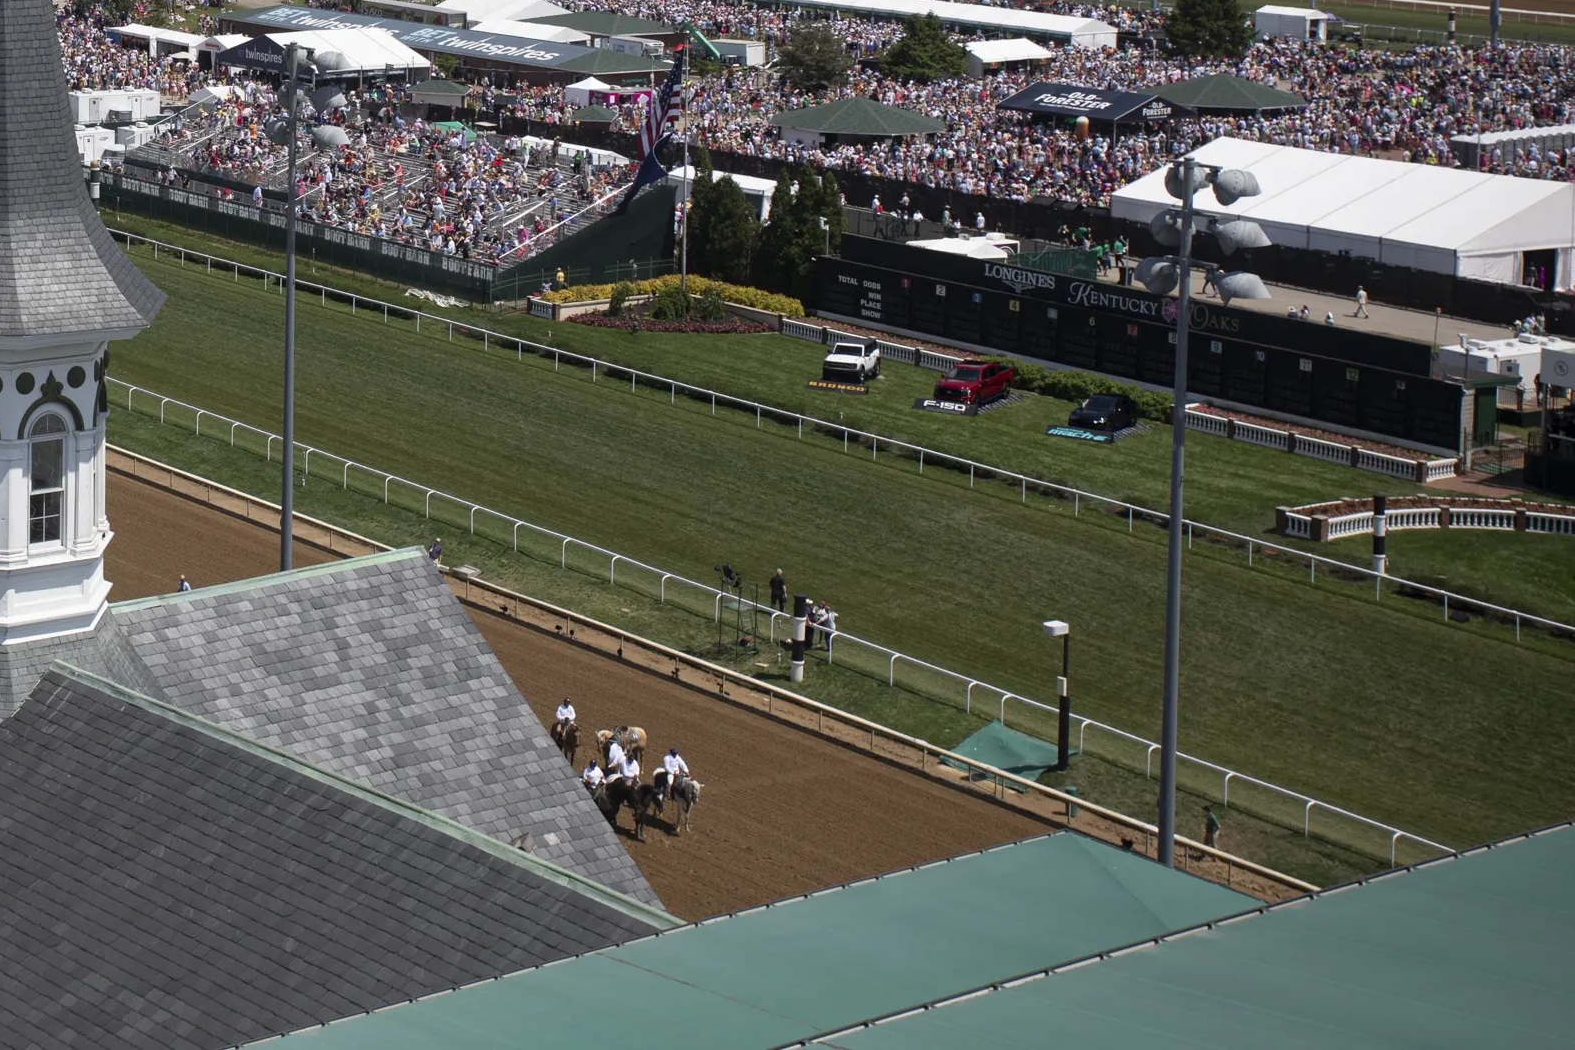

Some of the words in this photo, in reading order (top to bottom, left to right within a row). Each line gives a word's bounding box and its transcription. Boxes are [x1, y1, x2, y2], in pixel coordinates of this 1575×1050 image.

[267, 7, 310, 18] BET
[409, 28, 457, 39] BET
[438, 36, 559, 61] twinspires
[245, 45, 283, 64] twinspires
[1068, 92, 1097, 100] OLD
[1034, 94, 1112, 110] FORESTER
[1142, 108, 1172, 116] FORESTER
[985, 263, 1056, 289] LONGINES
[838, 275, 858, 286] TOTAL
[863, 280, 881, 290] ODDS
[868, 291, 882, 300] WIN
[861, 299, 882, 310] PLACE
[861, 309, 881, 319] SHOW
[1089, 317, 1095, 326] 6
[809, 381, 865, 392] BRONCO
[923, 400, 966, 412] F-150
